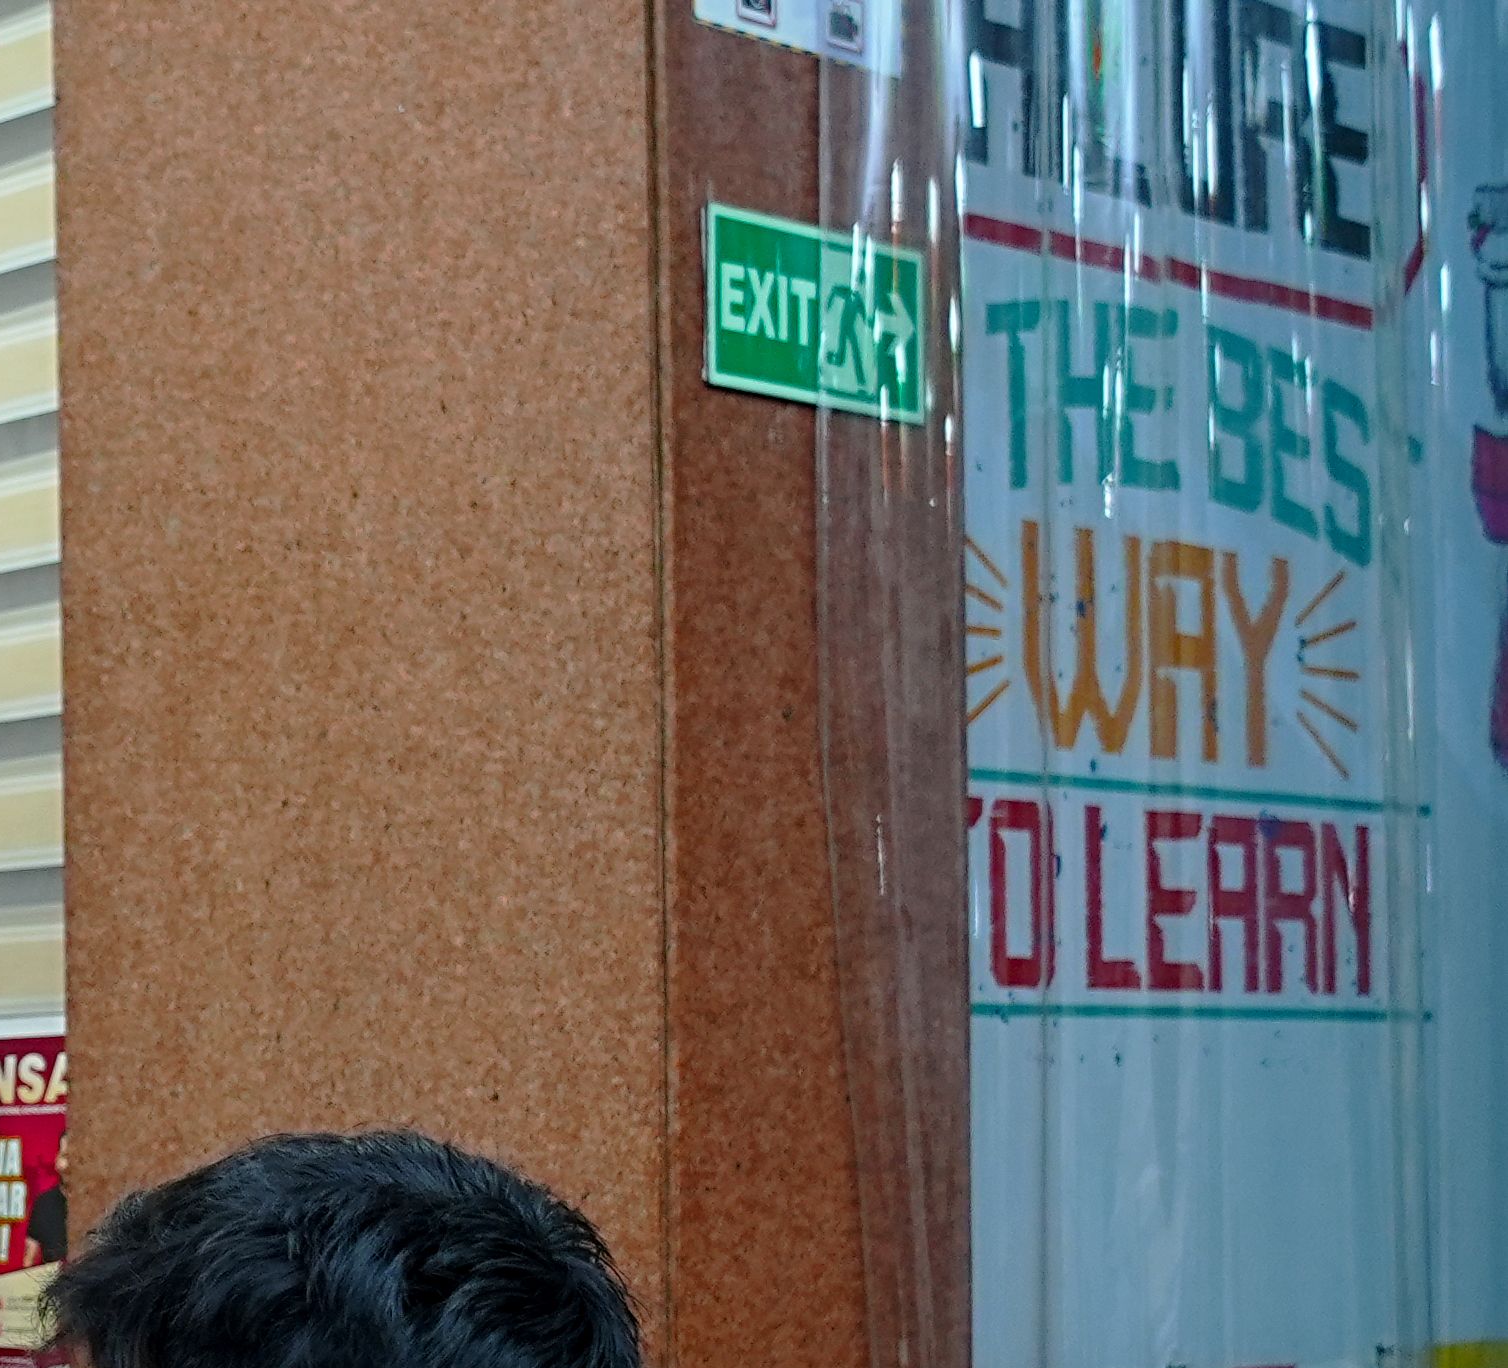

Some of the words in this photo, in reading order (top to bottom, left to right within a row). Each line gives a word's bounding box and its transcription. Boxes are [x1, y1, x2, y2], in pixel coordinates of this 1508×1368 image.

[719, 263, 818, 346] EXIT
[985, 295, 1181, 493] THE
[1204, 324, 1372, 568] BES
[1022, 520, 1289, 768] WAY
[1085, 804, 1372, 997] LEARN
